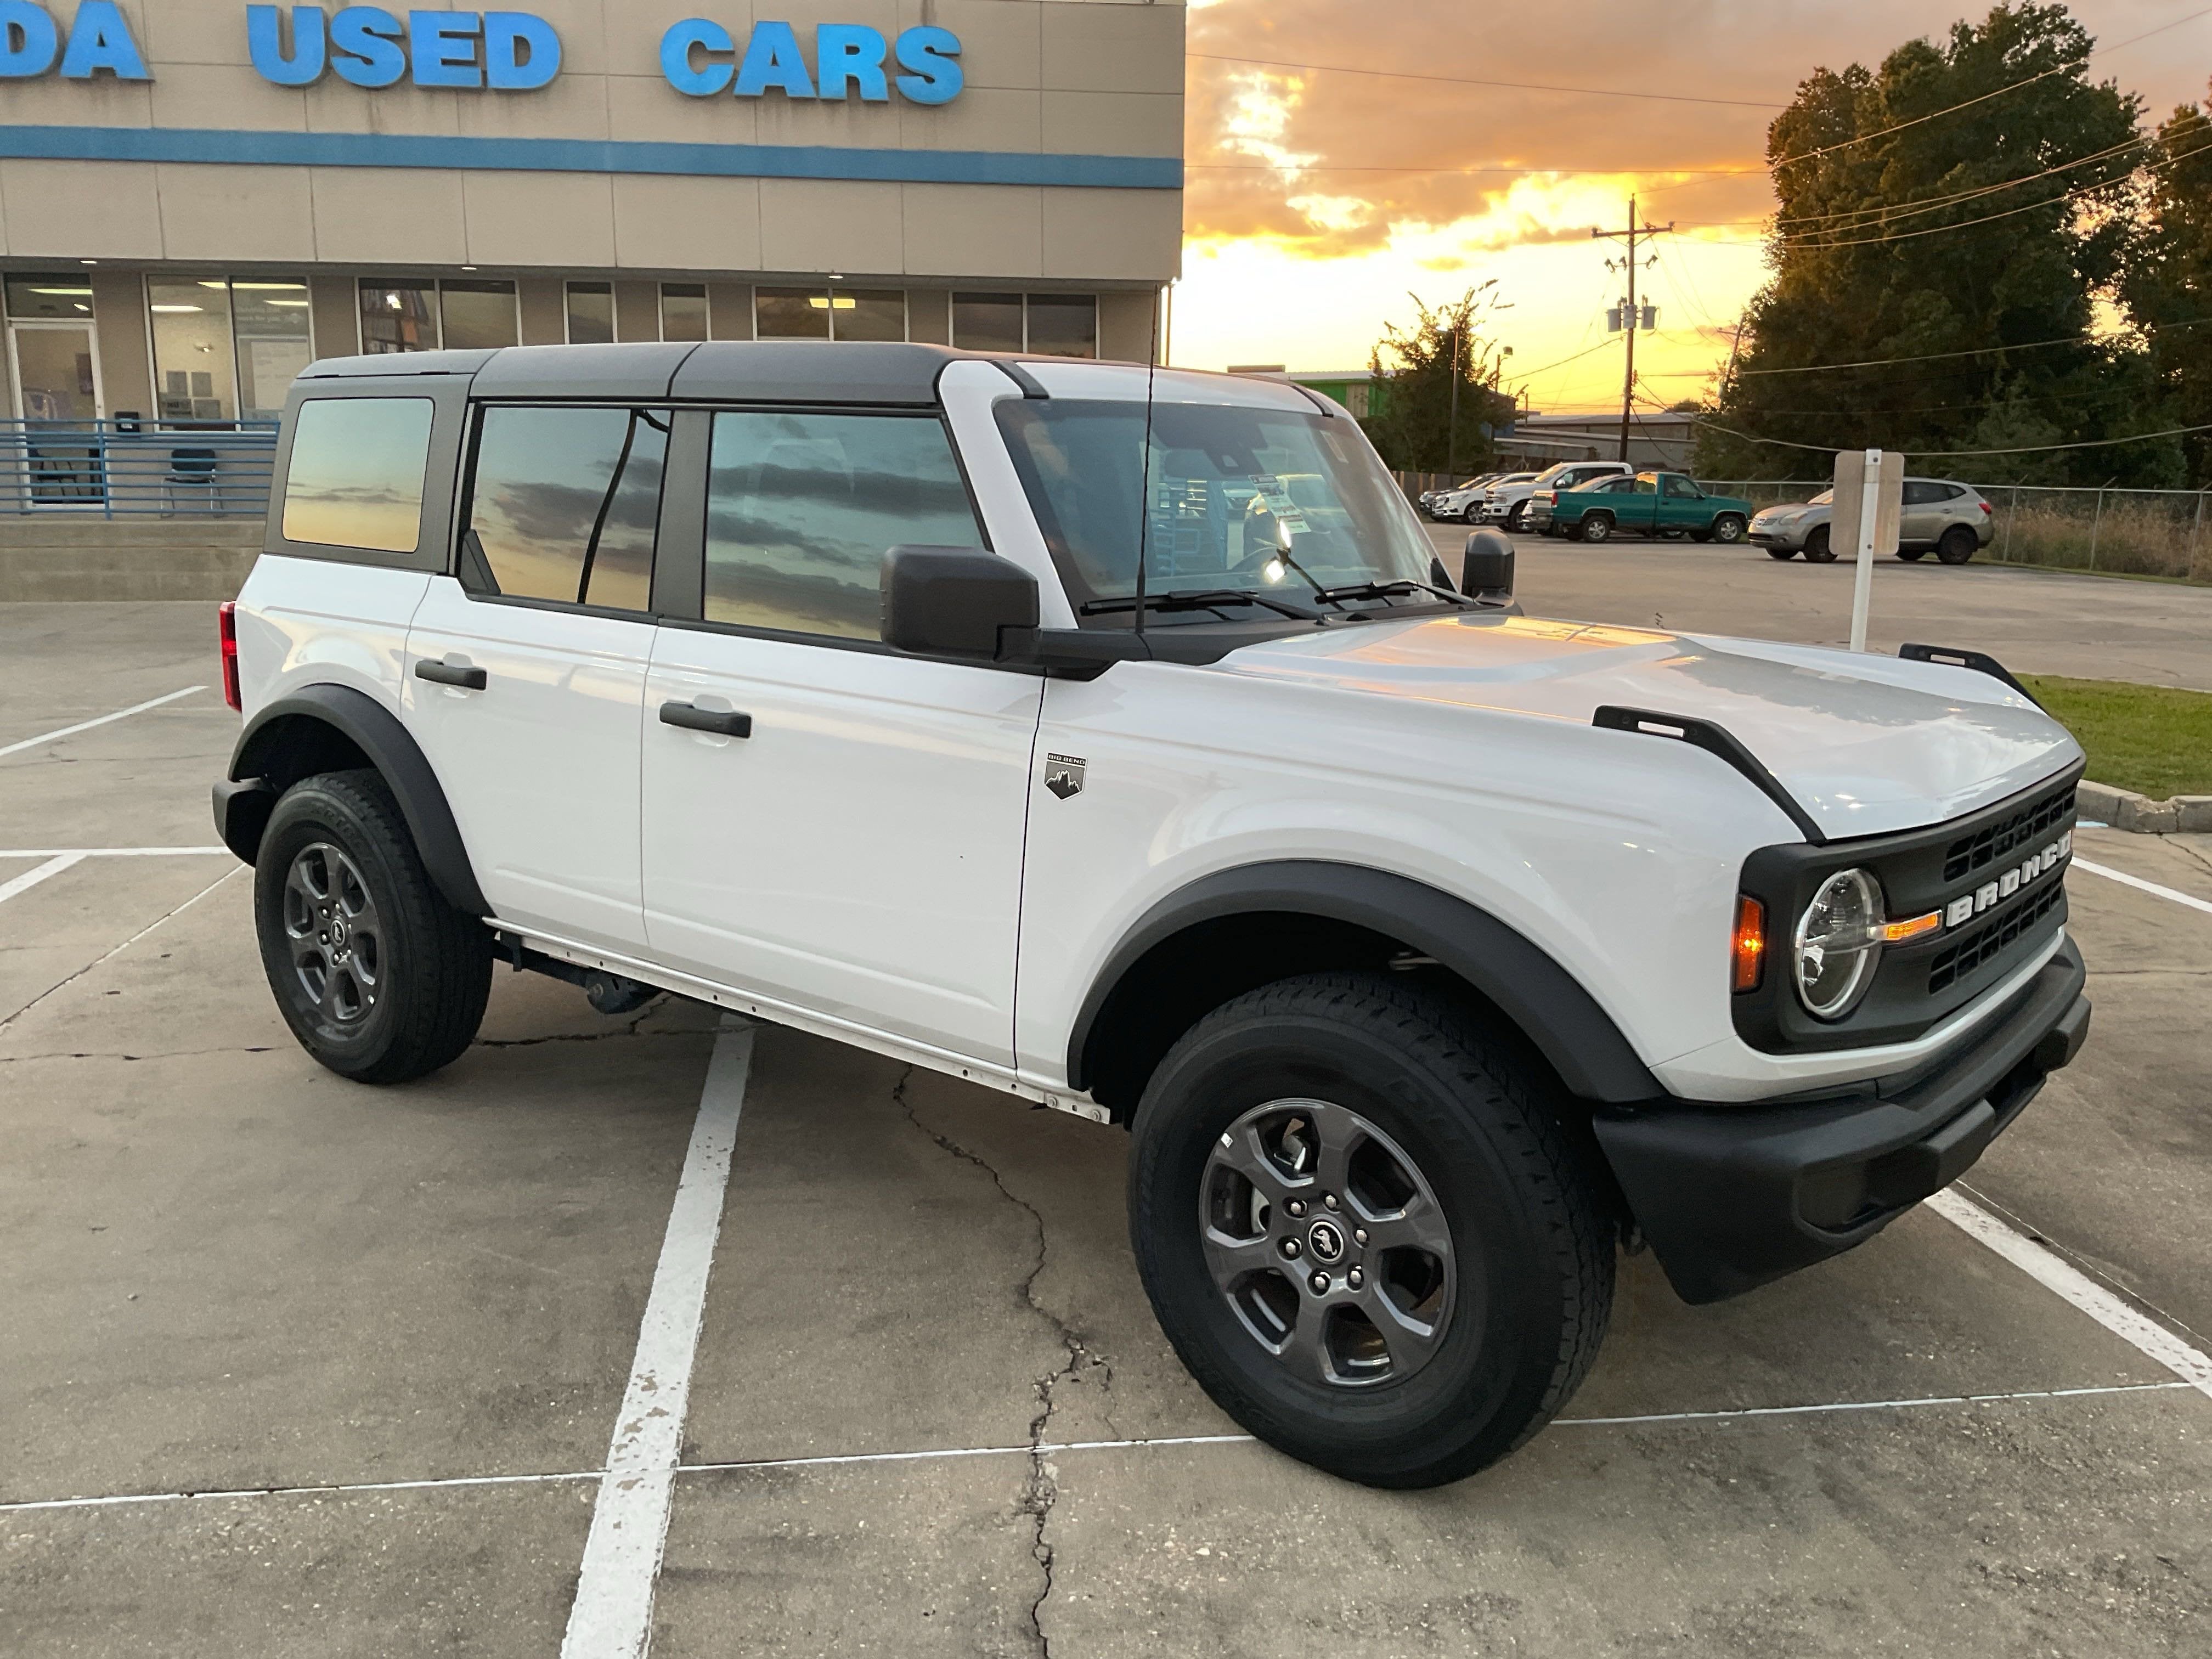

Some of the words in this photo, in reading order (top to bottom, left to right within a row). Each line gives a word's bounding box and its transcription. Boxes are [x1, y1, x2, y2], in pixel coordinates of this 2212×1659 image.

[246, 4, 562, 89] USED
[661, 18, 964, 105] CARS
[1946, 832, 2072, 927] BRONCO
